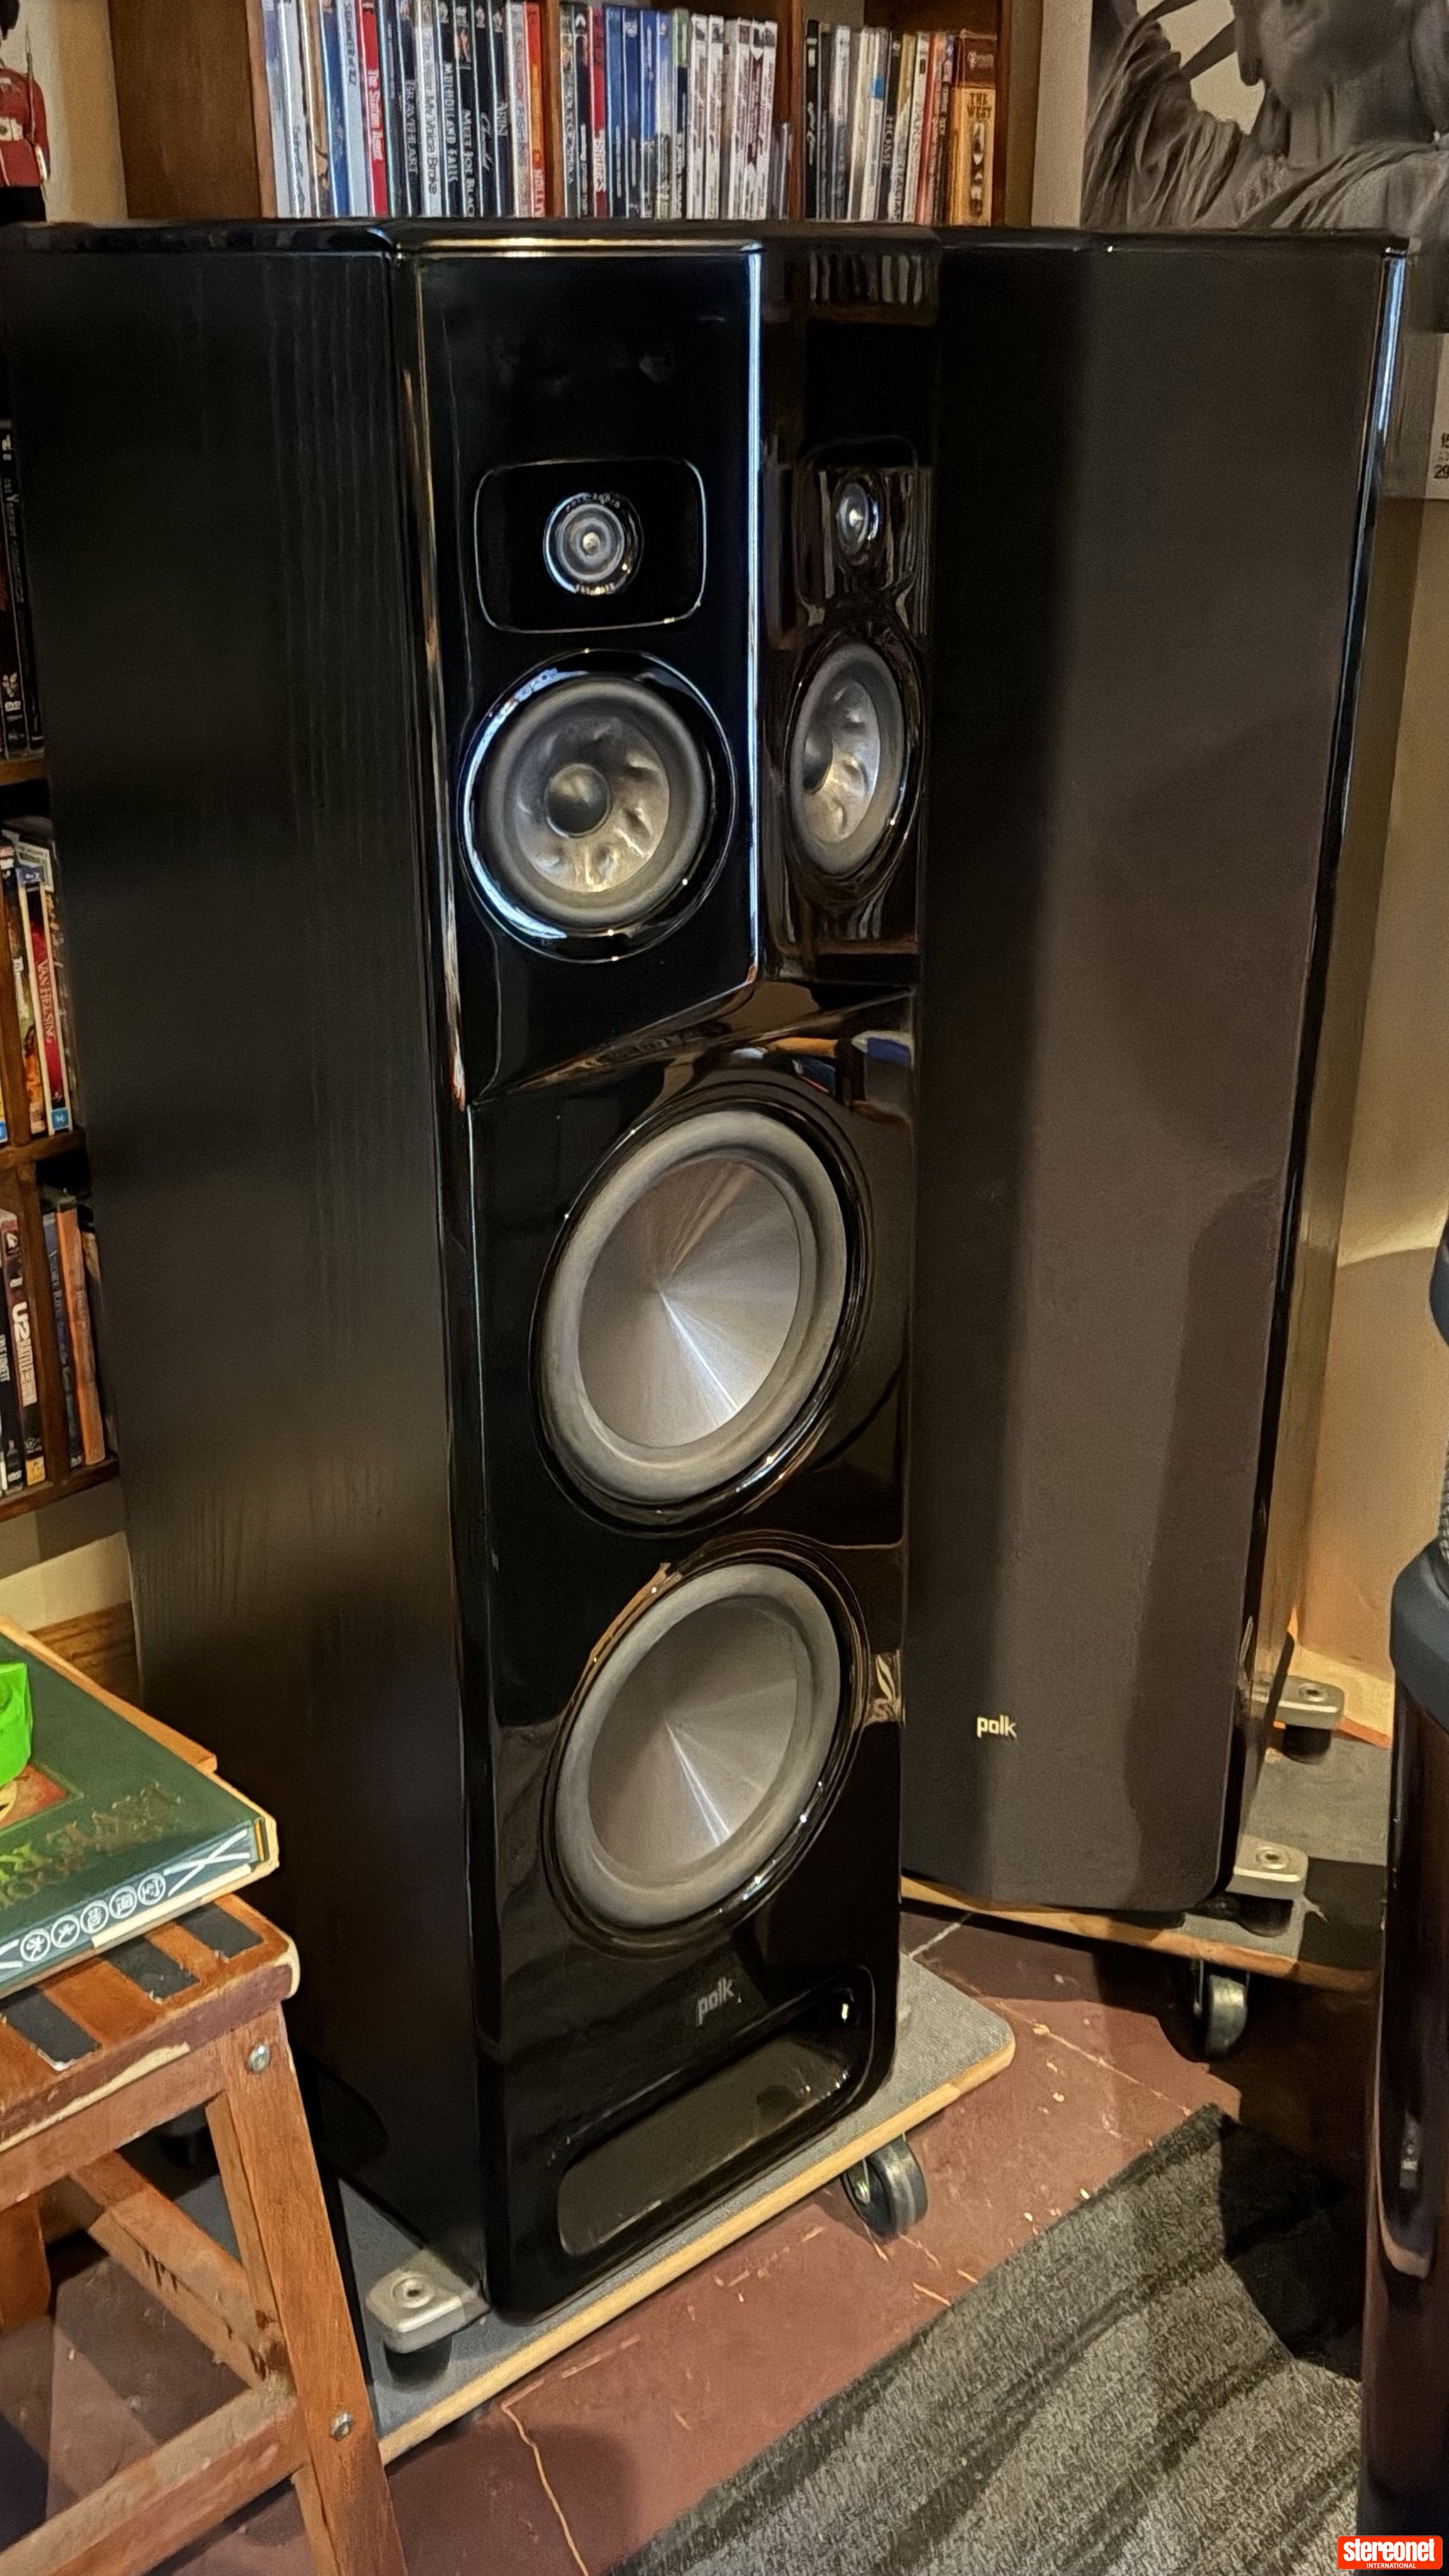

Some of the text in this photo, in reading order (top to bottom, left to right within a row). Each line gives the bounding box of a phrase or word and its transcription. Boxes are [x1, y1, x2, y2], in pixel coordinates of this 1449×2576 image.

[427, 155, 438, 195] Broke
[466, 176, 475, 218] BLAC
[36, 958, 57, 1045] VAN HELSING
[12, 1303, 31, 1342] U2
[976, 1714, 1017, 1738] polk
[696, 1976, 735, 2026] polk
